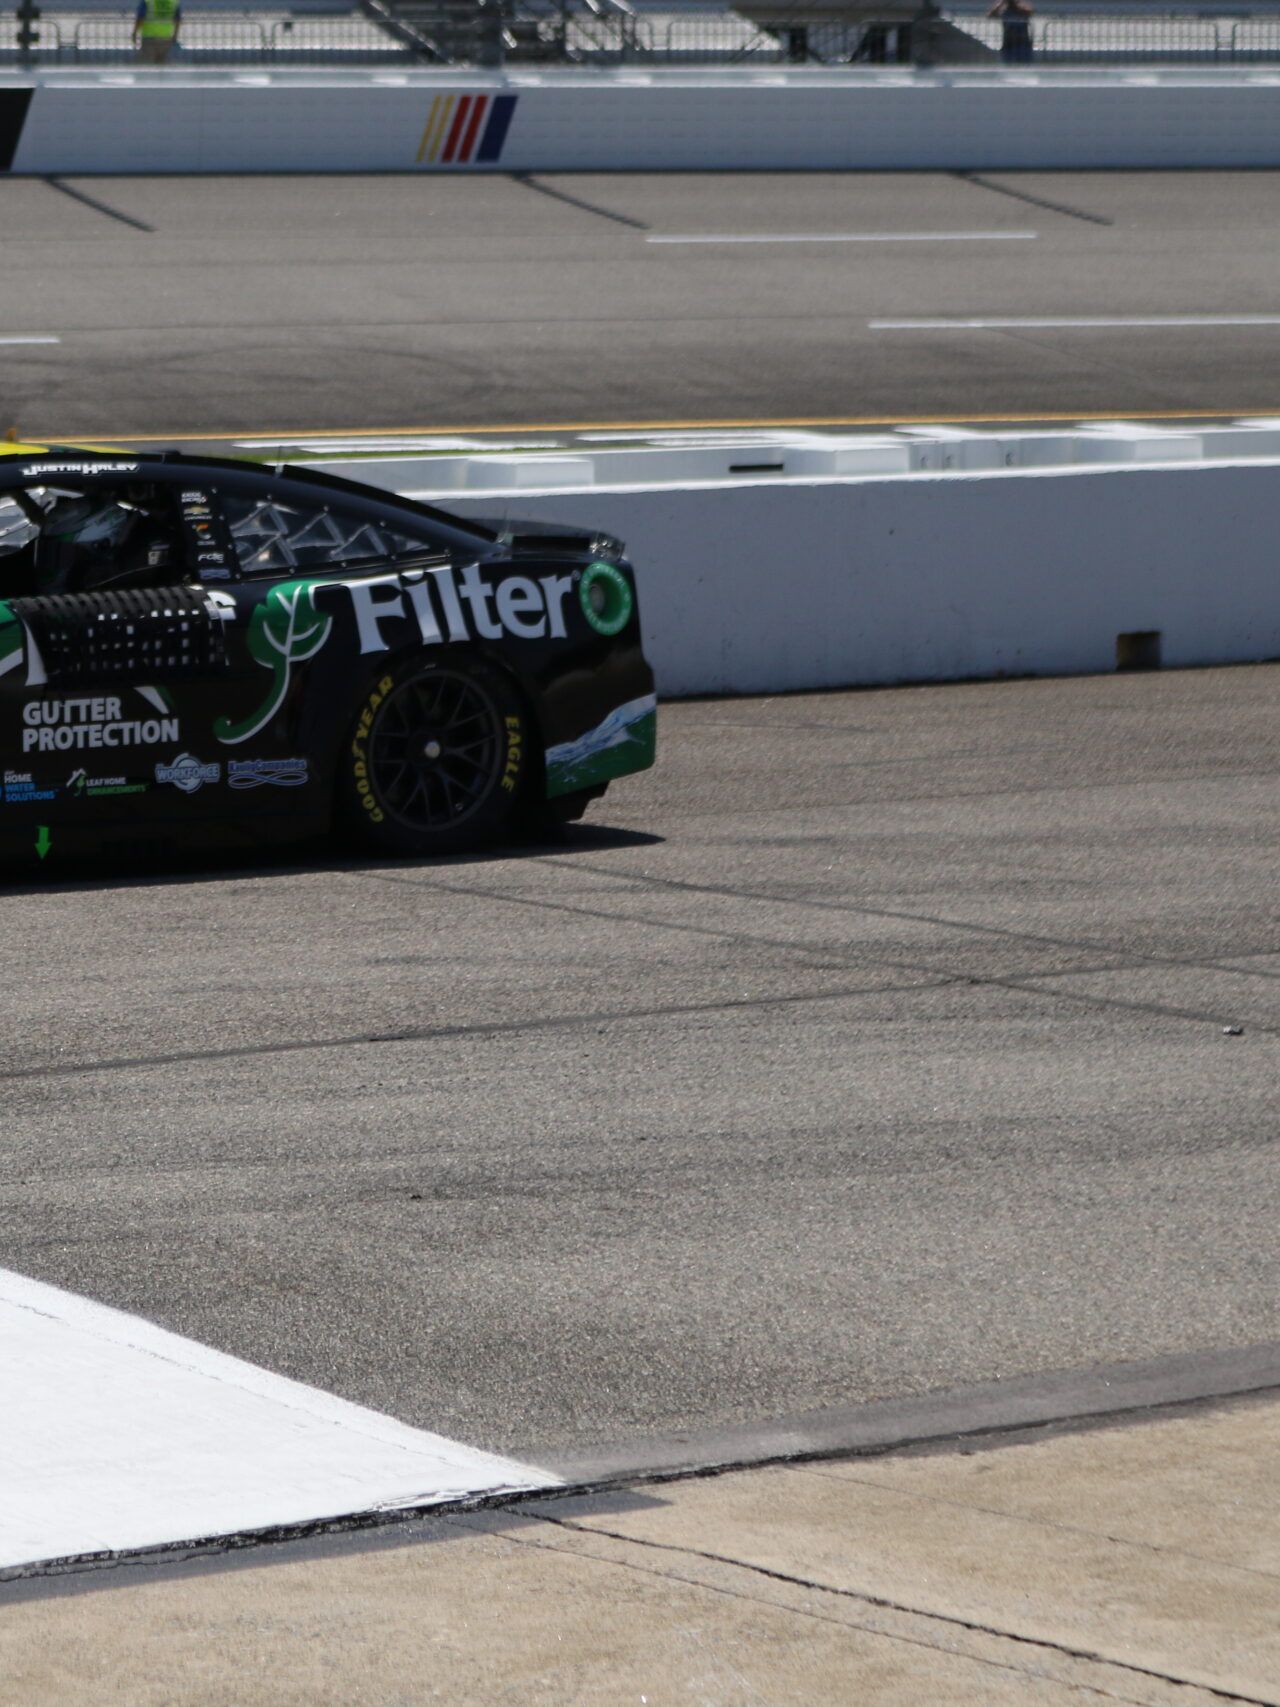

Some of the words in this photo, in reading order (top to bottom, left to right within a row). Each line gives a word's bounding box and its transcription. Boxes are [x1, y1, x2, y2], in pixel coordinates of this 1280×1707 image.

[338, 563, 573, 655] Filter
[22, 697, 122, 726] GUTTER
[22, 718, 179, 753] PROTECTION
[351, 675, 394, 824] GOODYEAR
[501, 715, 522, 792] EAGLE
[4, 773, 32, 784] HOME
[157, 765, 219, 781] WORKFORCE
[5, 783, 36, 793] WATER
[5, 790, 56, 802] SOLUTIONS
